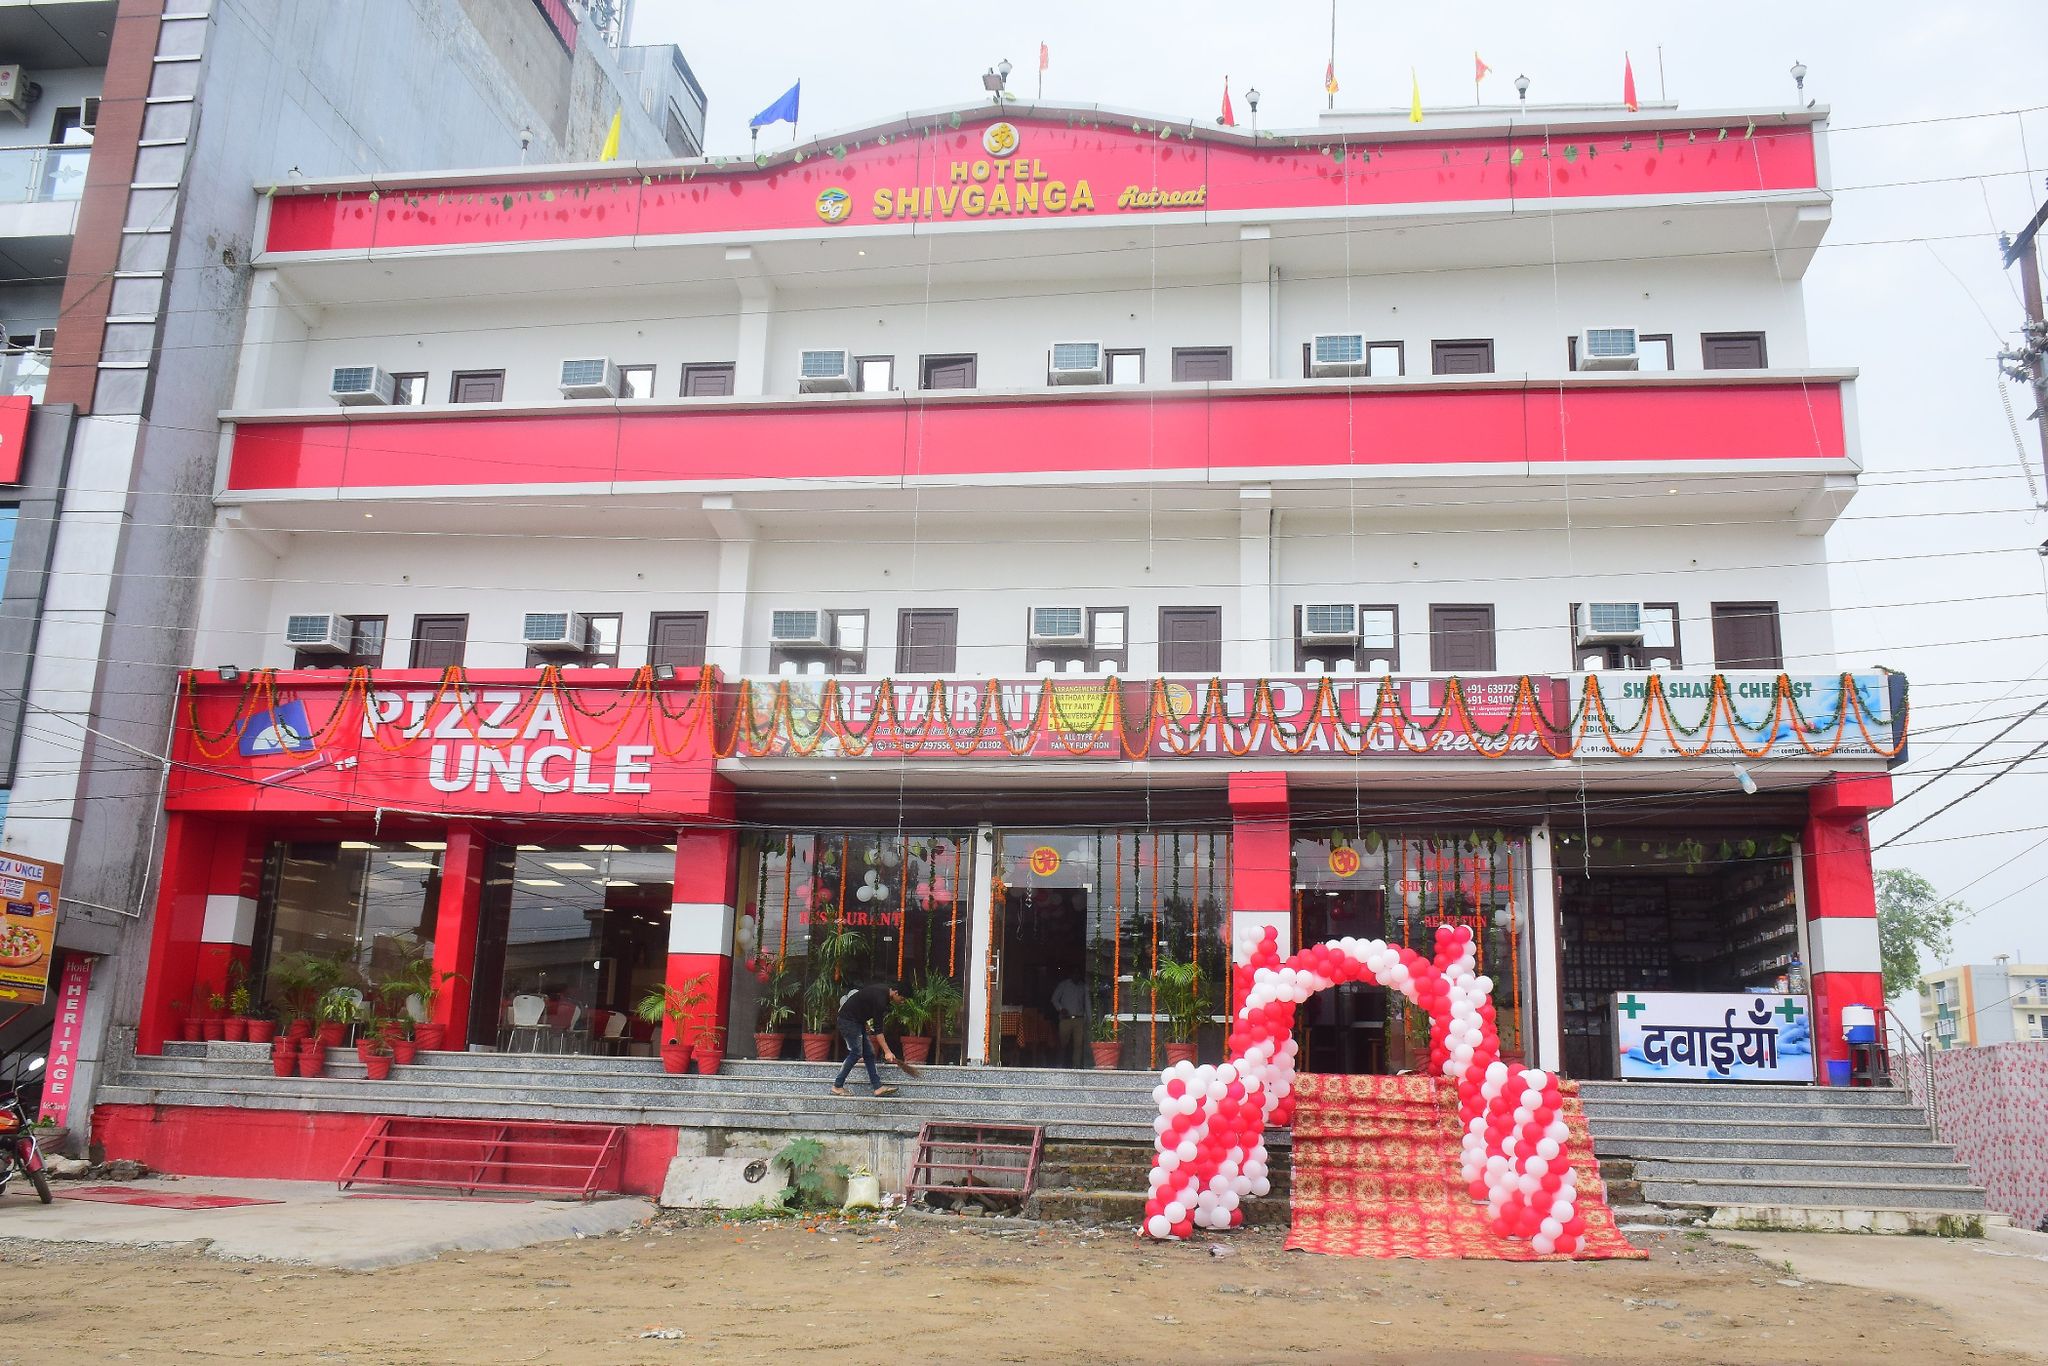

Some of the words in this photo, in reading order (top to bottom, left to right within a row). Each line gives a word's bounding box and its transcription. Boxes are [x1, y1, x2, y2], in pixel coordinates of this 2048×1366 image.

[950, 159, 1048, 183] HOTEL
[872, 180, 1095, 219] SHIVGANGA
[1117, 184, 1207, 209] Retreat
[1487, 684, 1540, 695] 6397296
[1668, 682, 1732, 699] SHAKI
[1738, 682, 1812, 699] CHEST
[361, 691, 568, 739] PIZZA
[1158, 722, 1428, 753] SHIVGANGA
[1430, 730, 1540, 752] Retreat
[427, 744, 655, 794] UNCLE
[15, 862, 43, 879] UNCLE
[799, 911, 903, 926] RSURNT
[51, 985, 81, 1095] HERITAGE
